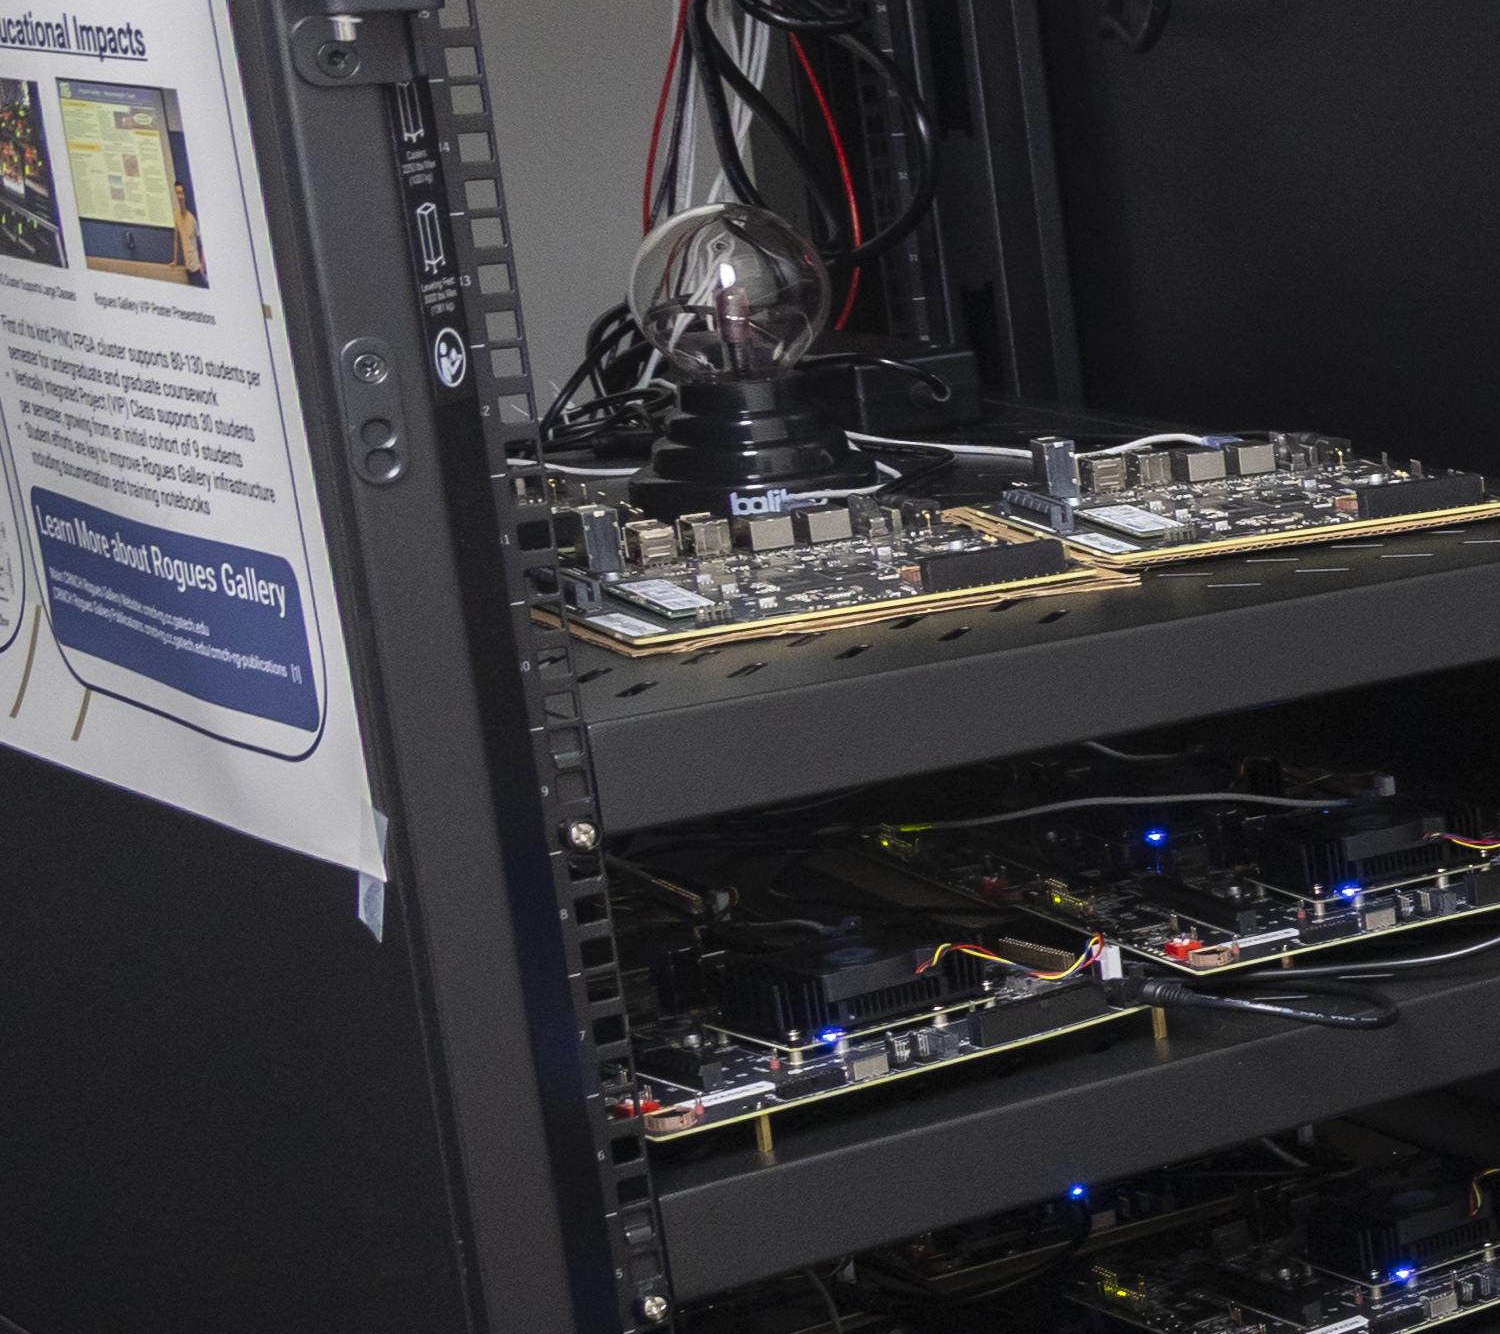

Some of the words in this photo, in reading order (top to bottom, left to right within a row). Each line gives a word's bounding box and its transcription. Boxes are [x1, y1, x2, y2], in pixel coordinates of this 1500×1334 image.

[0, 11, 71, 50] ucational
[73, 16, 146, 62] Impacts
[51, 356, 103, 381] undergraduate
[104, 369, 120, 387] and
[121, 374, 161, 394] graduate
[163, 383, 219, 407] coursework
[97, 339, 126, 360] cluster
[128, 346, 169, 368] supports
[205, 360, 246, 384] students
[247, 370, 261, 390] per
[106, 392, 129, 419] (VIP)
[130, 399, 155, 422] Class
[157, 408, 199, 431] supports
[200, 413, 213, 433] 30
[215, 419, 255, 443] students
[112, 426, 123, 441] an
[123, 425, 148, 448] initial
[148, 432, 178, 454] cohort
[181, 438, 191, 457] of
[192, 440, 199, 458] 9
[201, 444, 243, 468] students
[109, 449, 141, 473] improve
[141, 455, 176, 482] Rogues
[178, 464, 211, 493] Gallery
[213, 471, 276, 504] infrastructure
[112, 477, 128, 495] and
[127, 480, 160, 508] training
[160, 489, 211, 516] notebooks
[35, 504, 76, 546] Learn
[74, 517, 111, 558] More
[111, 531, 151, 574] about
[151, 545, 218, 593] Rogues
[221, 562, 286, 618] Gallery
